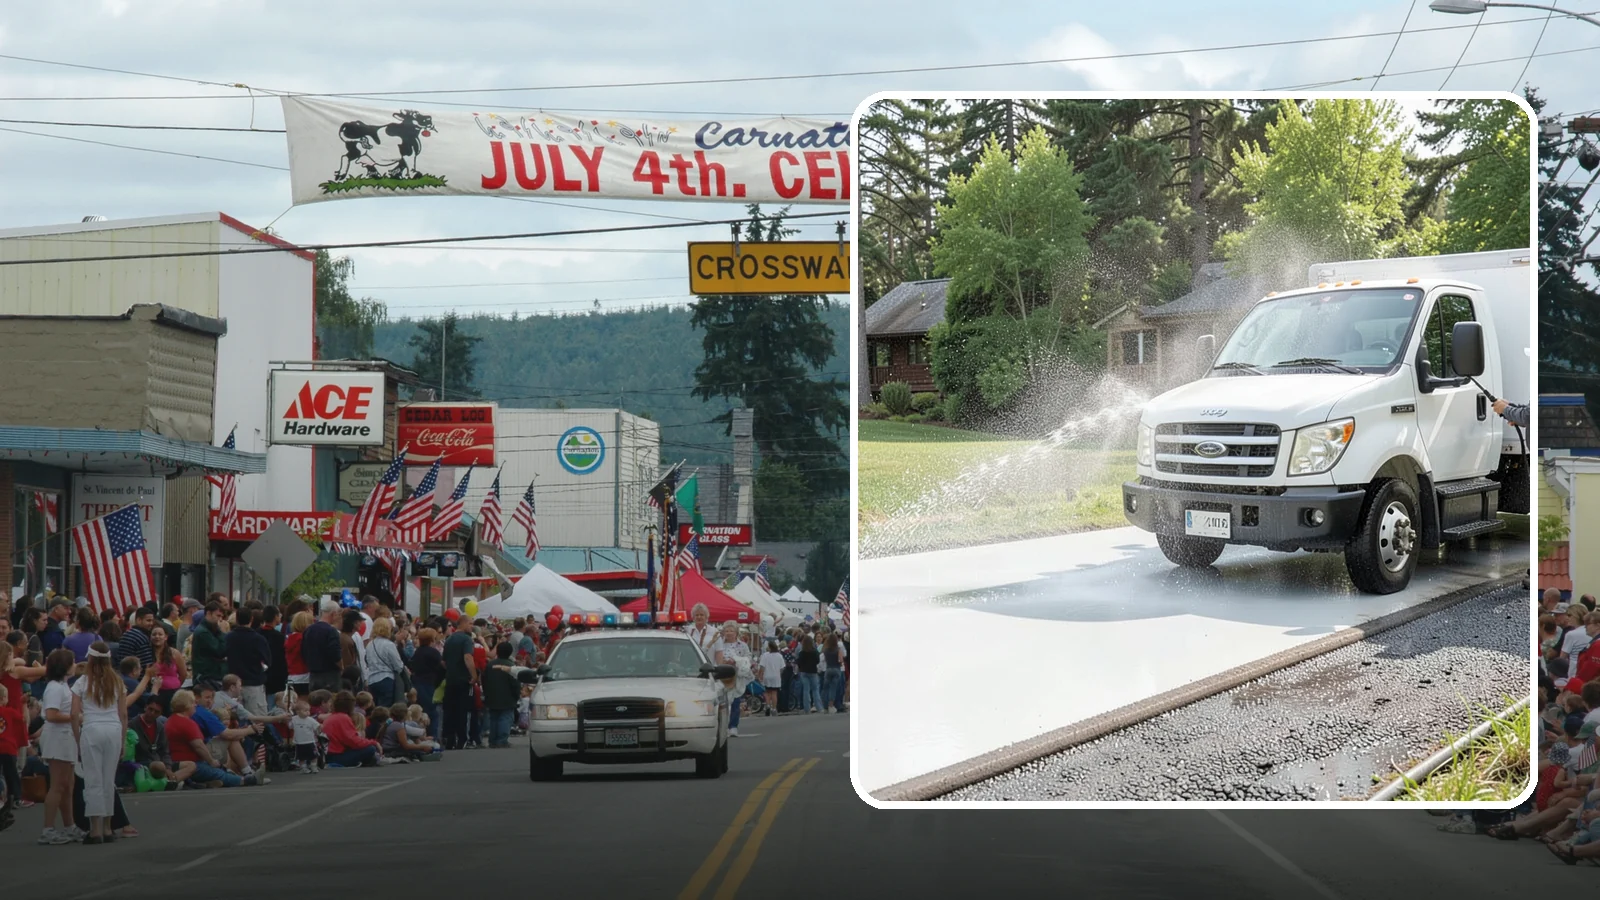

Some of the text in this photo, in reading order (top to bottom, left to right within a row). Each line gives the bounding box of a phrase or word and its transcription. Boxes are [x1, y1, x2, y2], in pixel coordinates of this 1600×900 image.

[481, 141, 605, 192] JULY
[632, 150, 746, 198] 4th.
[697, 254, 850, 280] CROSSWA
[283, 380, 373, 420] ACE
[406, 409, 485, 421] CEDAR LOG
[283, 421, 370, 436] Hardware
[416, 428, 477, 447] Coca-Cola
[83, 485, 155, 495] St. Vincent de Paul
[688, 526, 741, 535] CRNATION
[699, 535, 730, 543] GLASS
